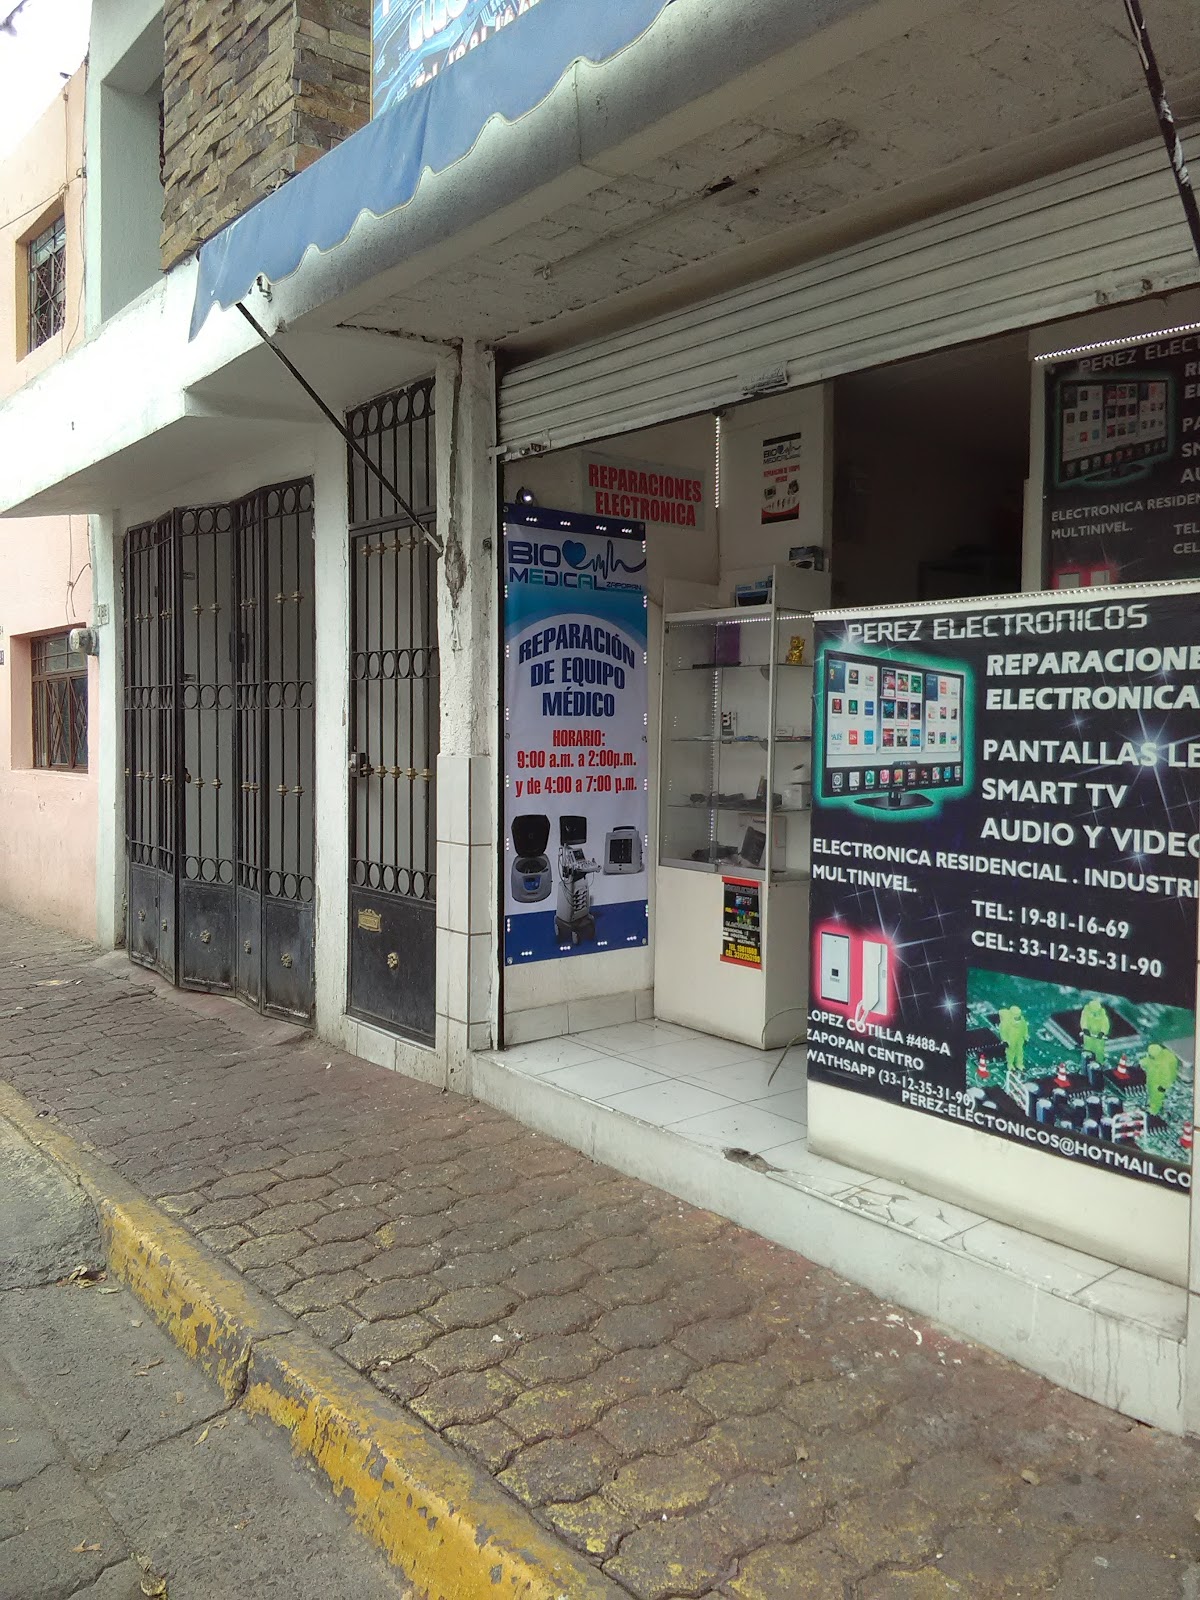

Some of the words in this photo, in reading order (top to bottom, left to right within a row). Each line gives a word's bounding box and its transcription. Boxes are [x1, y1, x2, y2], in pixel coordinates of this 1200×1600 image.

[1079, 350, 1137, 373] PEREZ
[1185, 361, 1200, 377] R
[588, 464, 702, 503] REPARACIONES
[595, 491, 696, 527] ELECTRONICA
[1051, 501, 1144, 521] ELECTRONICA
[1051, 521, 1133, 539] MULTINIVEL.
[508, 541, 561, 568] BIO
[509, 567, 606, 591] MEDICAL
[606, 581, 642, 591] ZAPOPAN
[849, 620, 922, 644] PEREZ
[933, 604, 1149, 641] ELECTRONICOS
[518, 623, 635, 670] REPARACIÓN
[985, 645, 1200, 676] REPARACIONE
[530, 659, 555, 688] DE
[561, 656, 626, 690] EQUIPO
[542, 686, 615, 717] MÉDICO
[985, 684, 1200, 711] ELECTRONICA
[552, 729, 606, 747] HORARIO:
[983, 739, 1158, 768] PANTALLAS
[517, 750, 546, 769] 9:00
[549, 753, 575, 768] a.m.
[577, 753, 585, 767] a
[588, 749, 637, 769] 2:00p.m.
[515, 780, 523, 797] y
[527, 777, 541, 795] de
[544, 776, 572, 793] 4:00
[575, 778, 583, 793] a
[585, 775, 612, 792] 7:00
[615, 777, 637, 794] p.m.
[982, 778, 1085, 807] SMART
[1086, 784, 1128, 809] TV
[980, 817, 1075, 847] AUDIO
[1082, 824, 1104, 849] Y
[812, 838, 931, 867] ELECTRONICA
[936, 852, 1067, 884] RESIDENCIAL
[1084, 867, 1199, 899] INDUSTRI
[812, 864, 917, 893] MULTINIVEL.
[971, 900, 1014, 922] TEL:
[1021, 907, 1130, 939] 19-81-16-69
[971, 930, 1014, 952] CEL:
[1019, 938, 1162, 978] 33-12-35-31-90
[807, 1028, 865, 1055] ZAPOPAN
[867, 1045, 924, 1071] CENTRO
[846, 1018, 904, 1044] COTILLA
[905, 1033, 951, 1057] #488-A
[807, 1048, 876, 1078] WATHSAPP
[878, 1068, 976, 1112] (33-12-35-31-90)
[901, 1089, 1192, 1188] PEREZ-ELECTONICOS@HOTMAIL.CO
